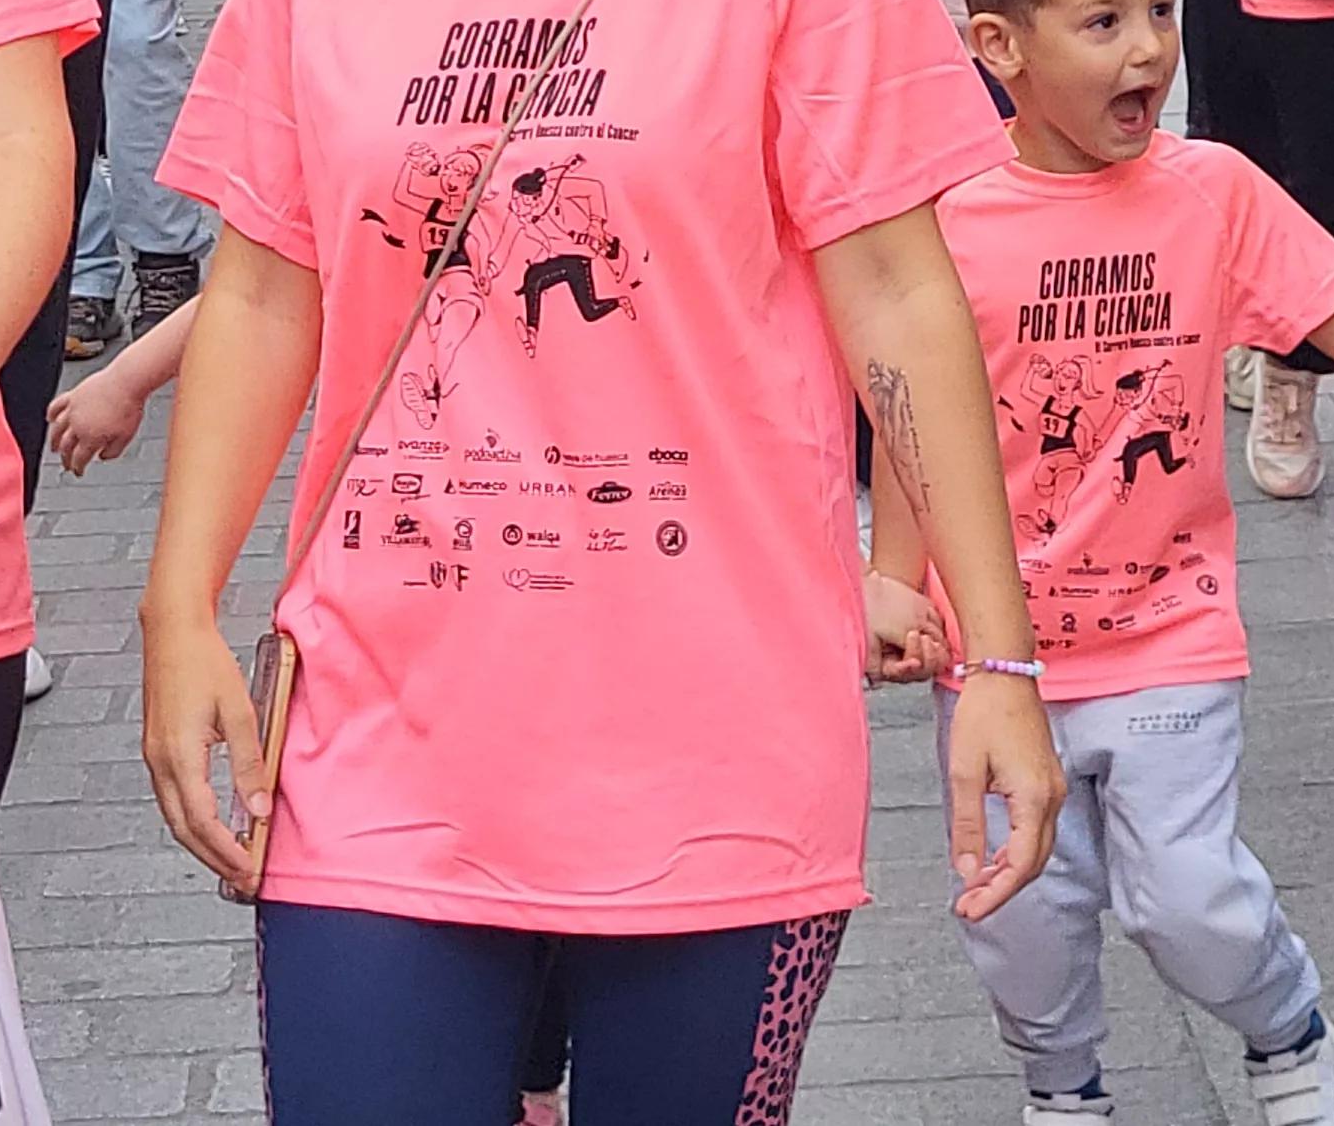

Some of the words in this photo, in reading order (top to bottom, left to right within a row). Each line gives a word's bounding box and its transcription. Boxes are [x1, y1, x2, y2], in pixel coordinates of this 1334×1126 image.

[438, 17, 598, 72] CORRAMOS
[396, 75, 459, 126] POR
[460, 71, 497, 124] LA
[501, 68, 607, 124] CENCIA
[427, 227, 449, 244] 19
[1039, 252, 1156, 300] CORRAMOS
[1017, 302, 1058, 344] POR
[1064, 299, 1086, 340] LA
[1094, 290, 1172, 337] CIENCIA
[397, 440, 441, 454] avanza
[458, 478, 508, 491] Humeco
[519, 481, 577, 493] URBAN
[527, 528, 561, 545] walqa
